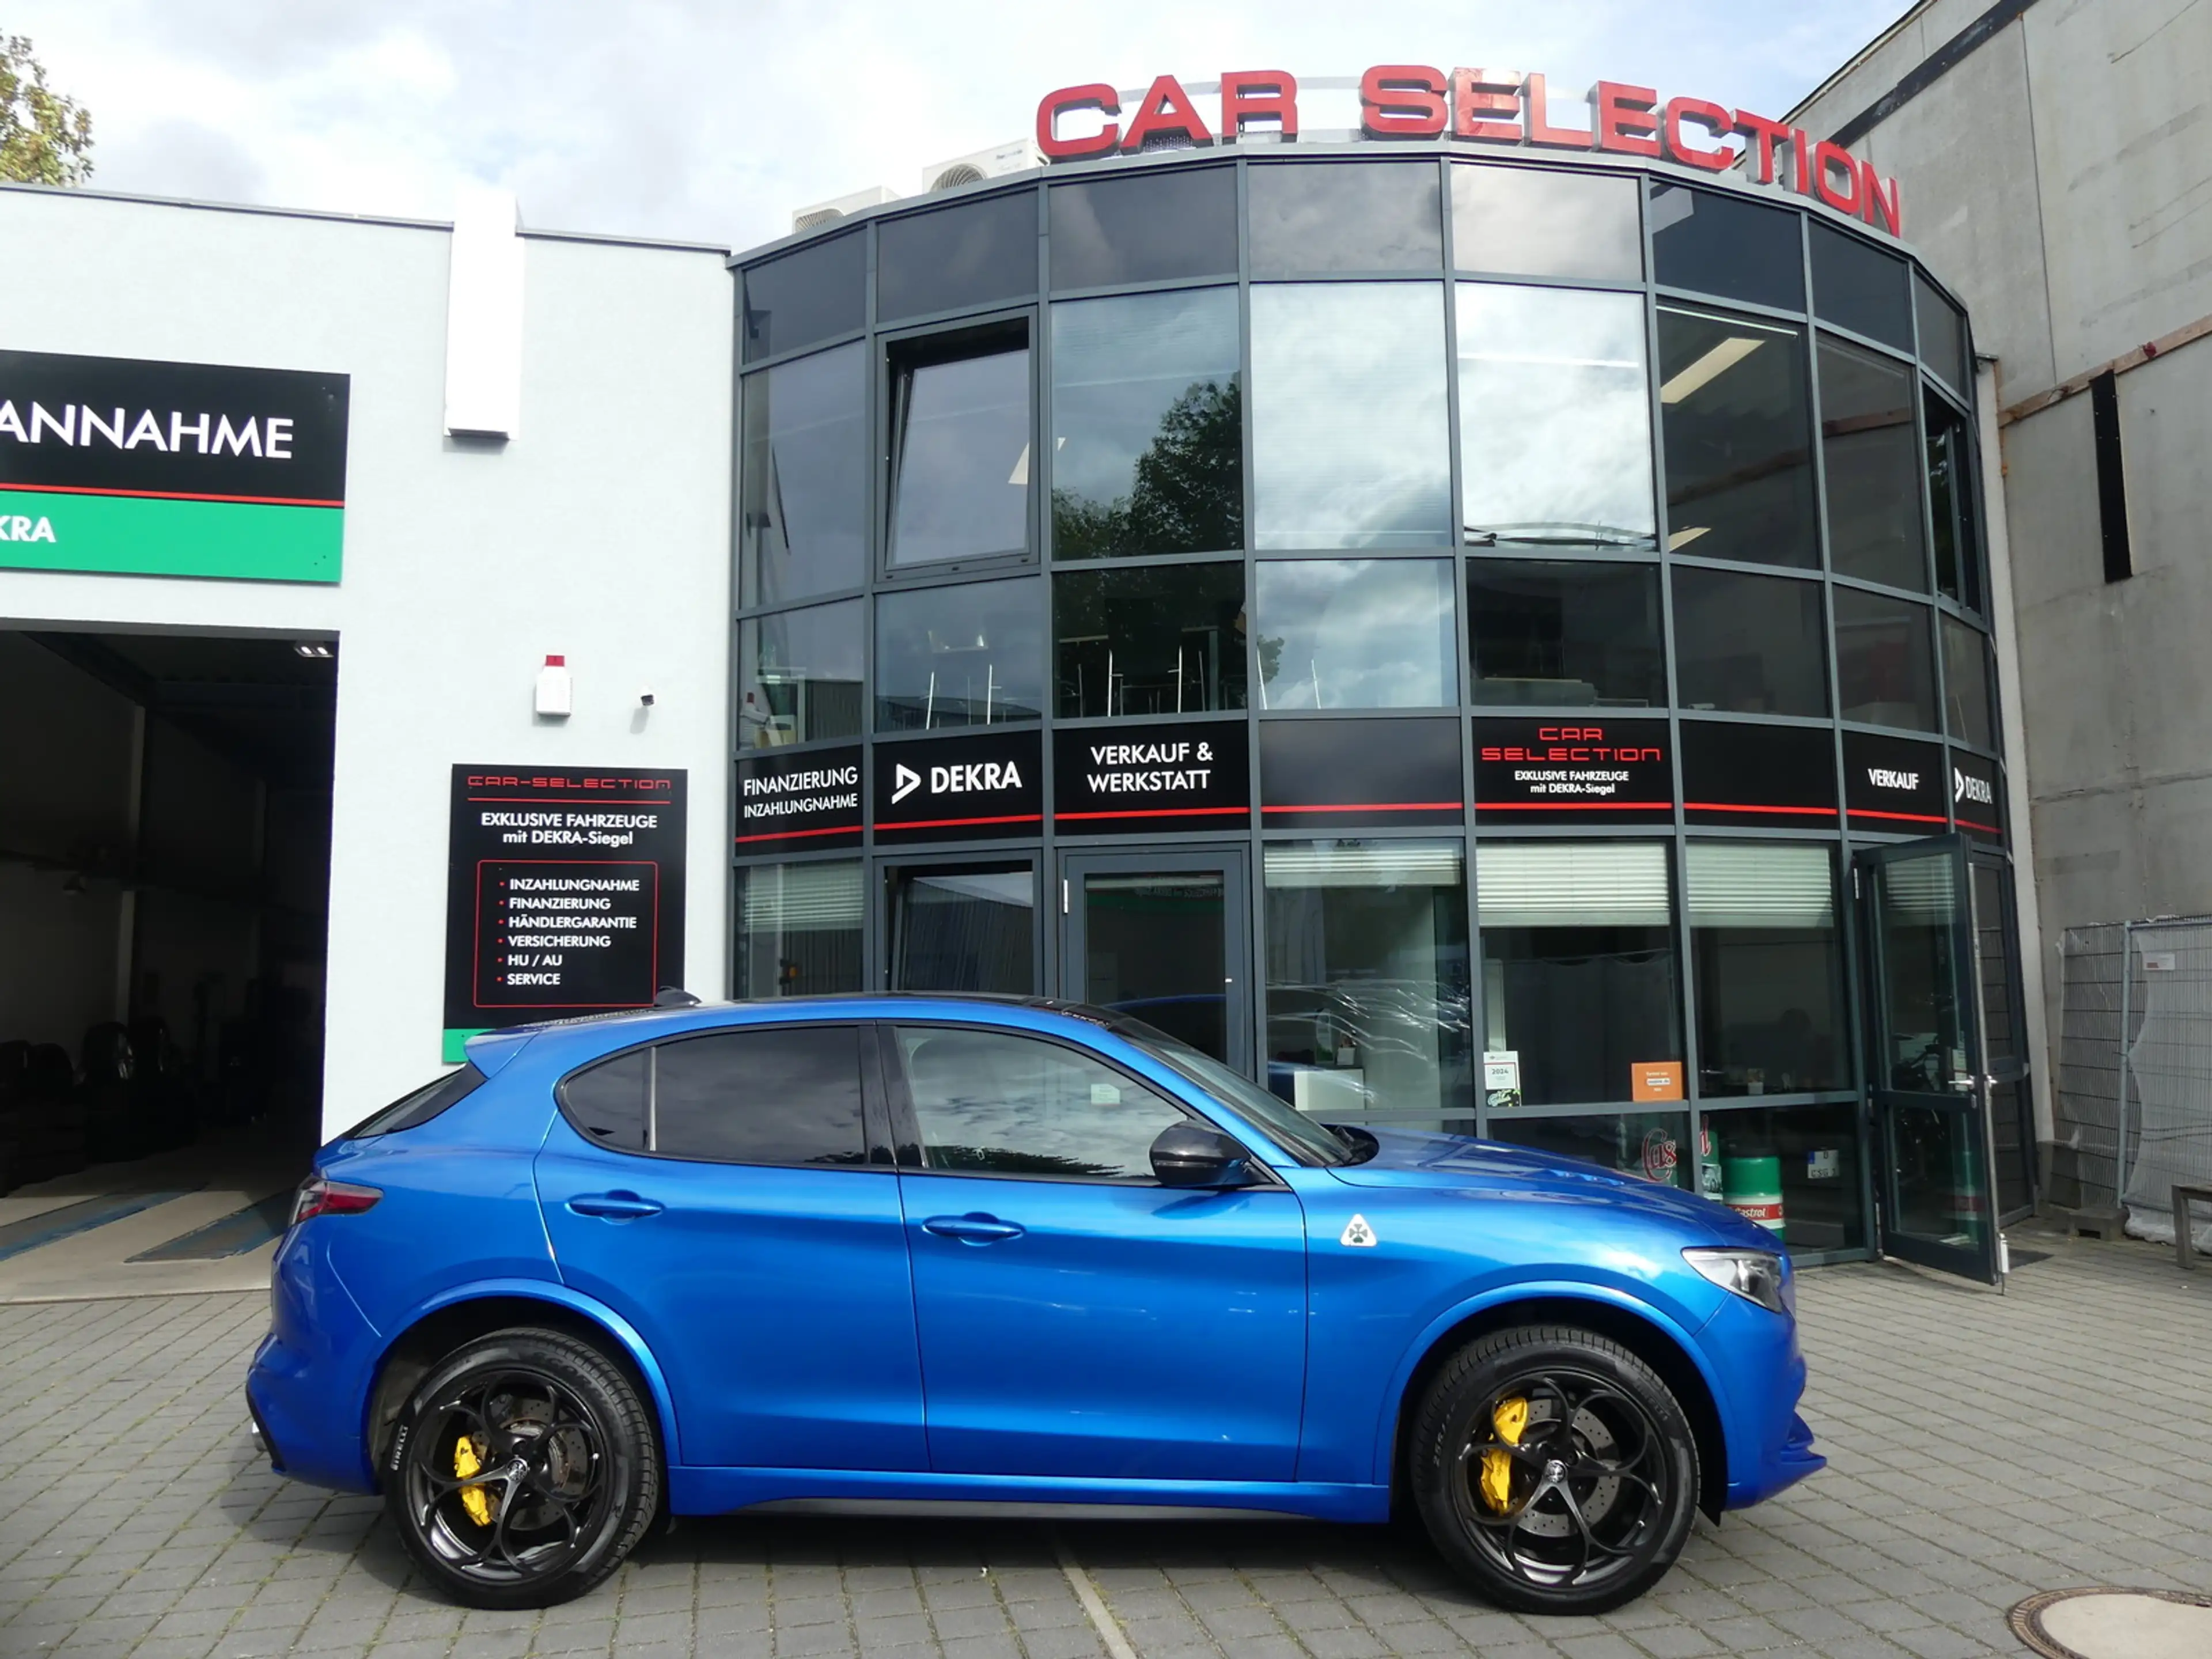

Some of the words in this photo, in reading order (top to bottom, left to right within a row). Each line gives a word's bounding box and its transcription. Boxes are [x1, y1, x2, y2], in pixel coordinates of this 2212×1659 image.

[1036, 70, 1298, 161] CAR
[1361, 65, 1901, 237] SELECTION
[0, 399, 294, 459] ANNAHME
[1538, 727, 1604, 741] CAR
[1090, 743, 1190, 766] VERKAUF
[1196, 742, 1213, 762] &
[1480, 747, 1662, 762] SELECTION
[467, 776, 671, 790] CAR-SELECTION
[744, 766, 858, 796] FINANZIERUNG
[931, 760, 1022, 794] DEKRA
[1086, 770, 1211, 793] WERKSTATT
[1514, 770, 1567, 781] EXKLUSIVE
[1569, 770, 1629, 782] FAHRZEUGE
[1868, 768, 1919, 790] VERKAUF
[1530, 783, 1547, 793] mit
[1548, 783, 1615, 796] DEKRA-Siegel
[1965, 775, 1993, 804] DEKRA
[744, 793, 858, 818] INZAHLUNGNAHME
[481, 812, 562, 828] EXKLUSIVE
[566, 813, 658, 828] FAHRZEUGE
[503, 830, 528, 843] mit
[531, 830, 633, 848] DEKRA-Siegel
[510, 878, 640, 891] INZAHLUNGNAHME
[509, 897, 611, 910] FINANZIERUNG
[509, 914, 637, 929] HÄNDLERGARANTIE
[507, 935, 612, 948] VERSICHERUNG
[507, 954, 529, 966] HU
[532, 954, 540, 967] /
[541, 954, 563, 966] AU
[507, 973, 560, 985] SERVICE
